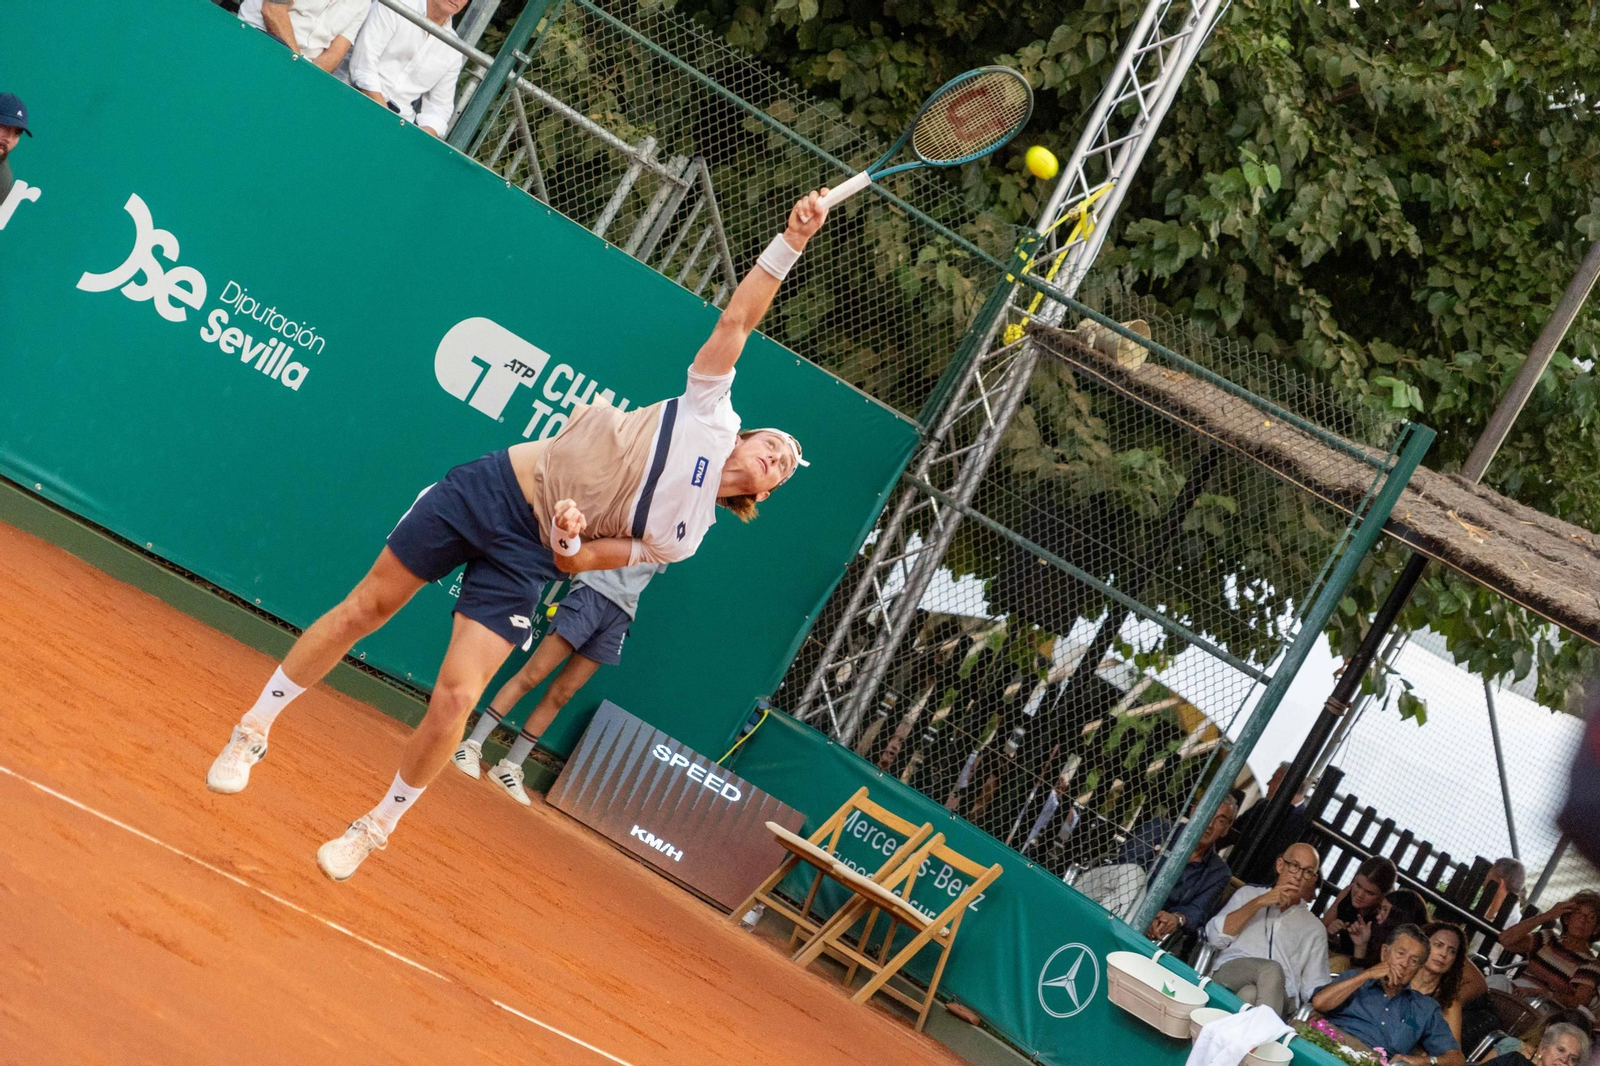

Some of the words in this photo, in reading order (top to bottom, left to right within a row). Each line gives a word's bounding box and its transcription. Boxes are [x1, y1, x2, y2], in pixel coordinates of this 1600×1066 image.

[200, 308, 310, 391] Sevilla
[219, 280, 326, 355] Diputación
[504, 358, 536, 379] ATP
[652, 744, 742, 802] SPEED
[630, 824, 684, 862] KM/H
[842, 809, 986, 911] Merces-Bez
